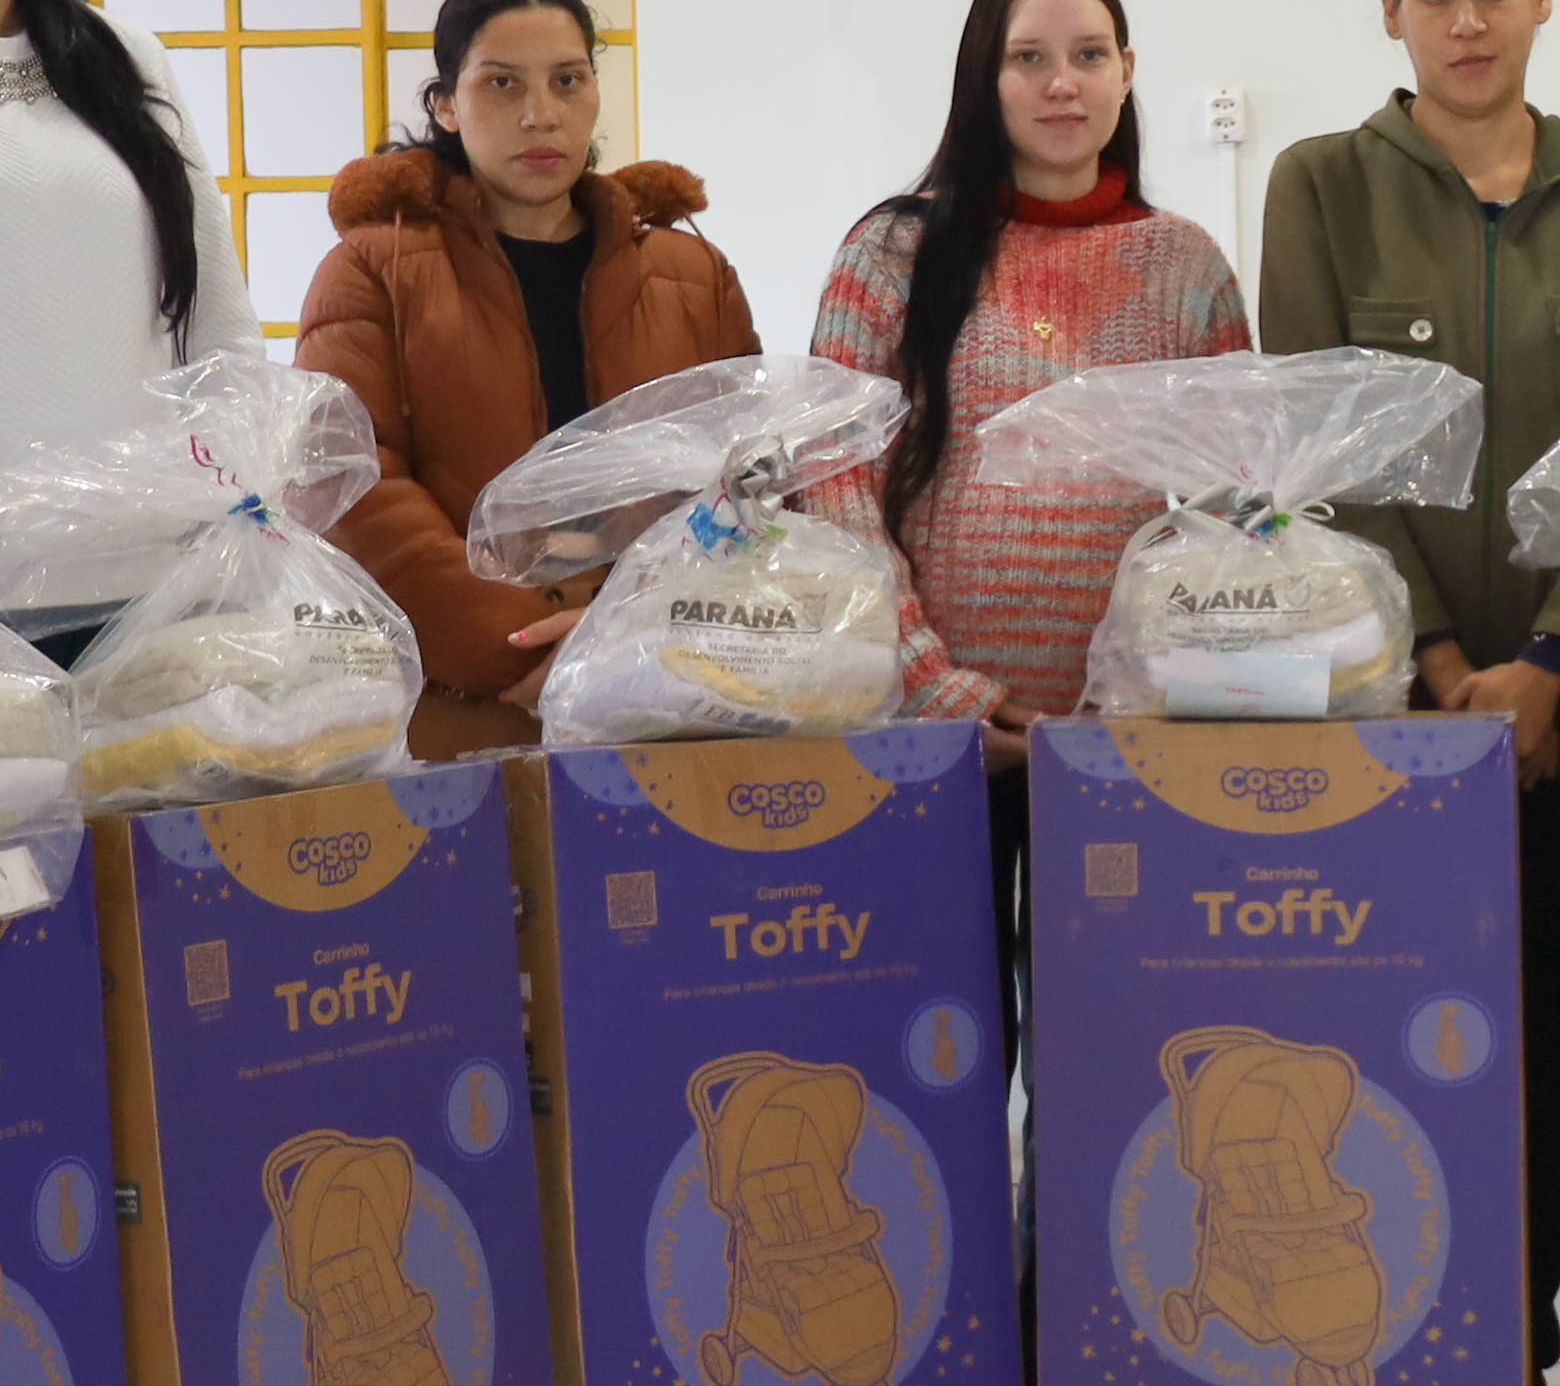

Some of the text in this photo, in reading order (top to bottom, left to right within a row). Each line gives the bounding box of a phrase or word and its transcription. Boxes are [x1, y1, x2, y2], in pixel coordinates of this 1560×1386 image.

[1257, 790, 1310, 812] kids
[762, 805, 810, 829] kids
[1246, 867, 1319, 881] Carrinho
[756, 882, 822, 901] Carrinho
[1193, 888, 1372, 945] Toffy
[710, 903, 870, 960] Toffy
[313, 943, 370, 966] Carrinho
[274, 963, 412, 1032] Toffy
